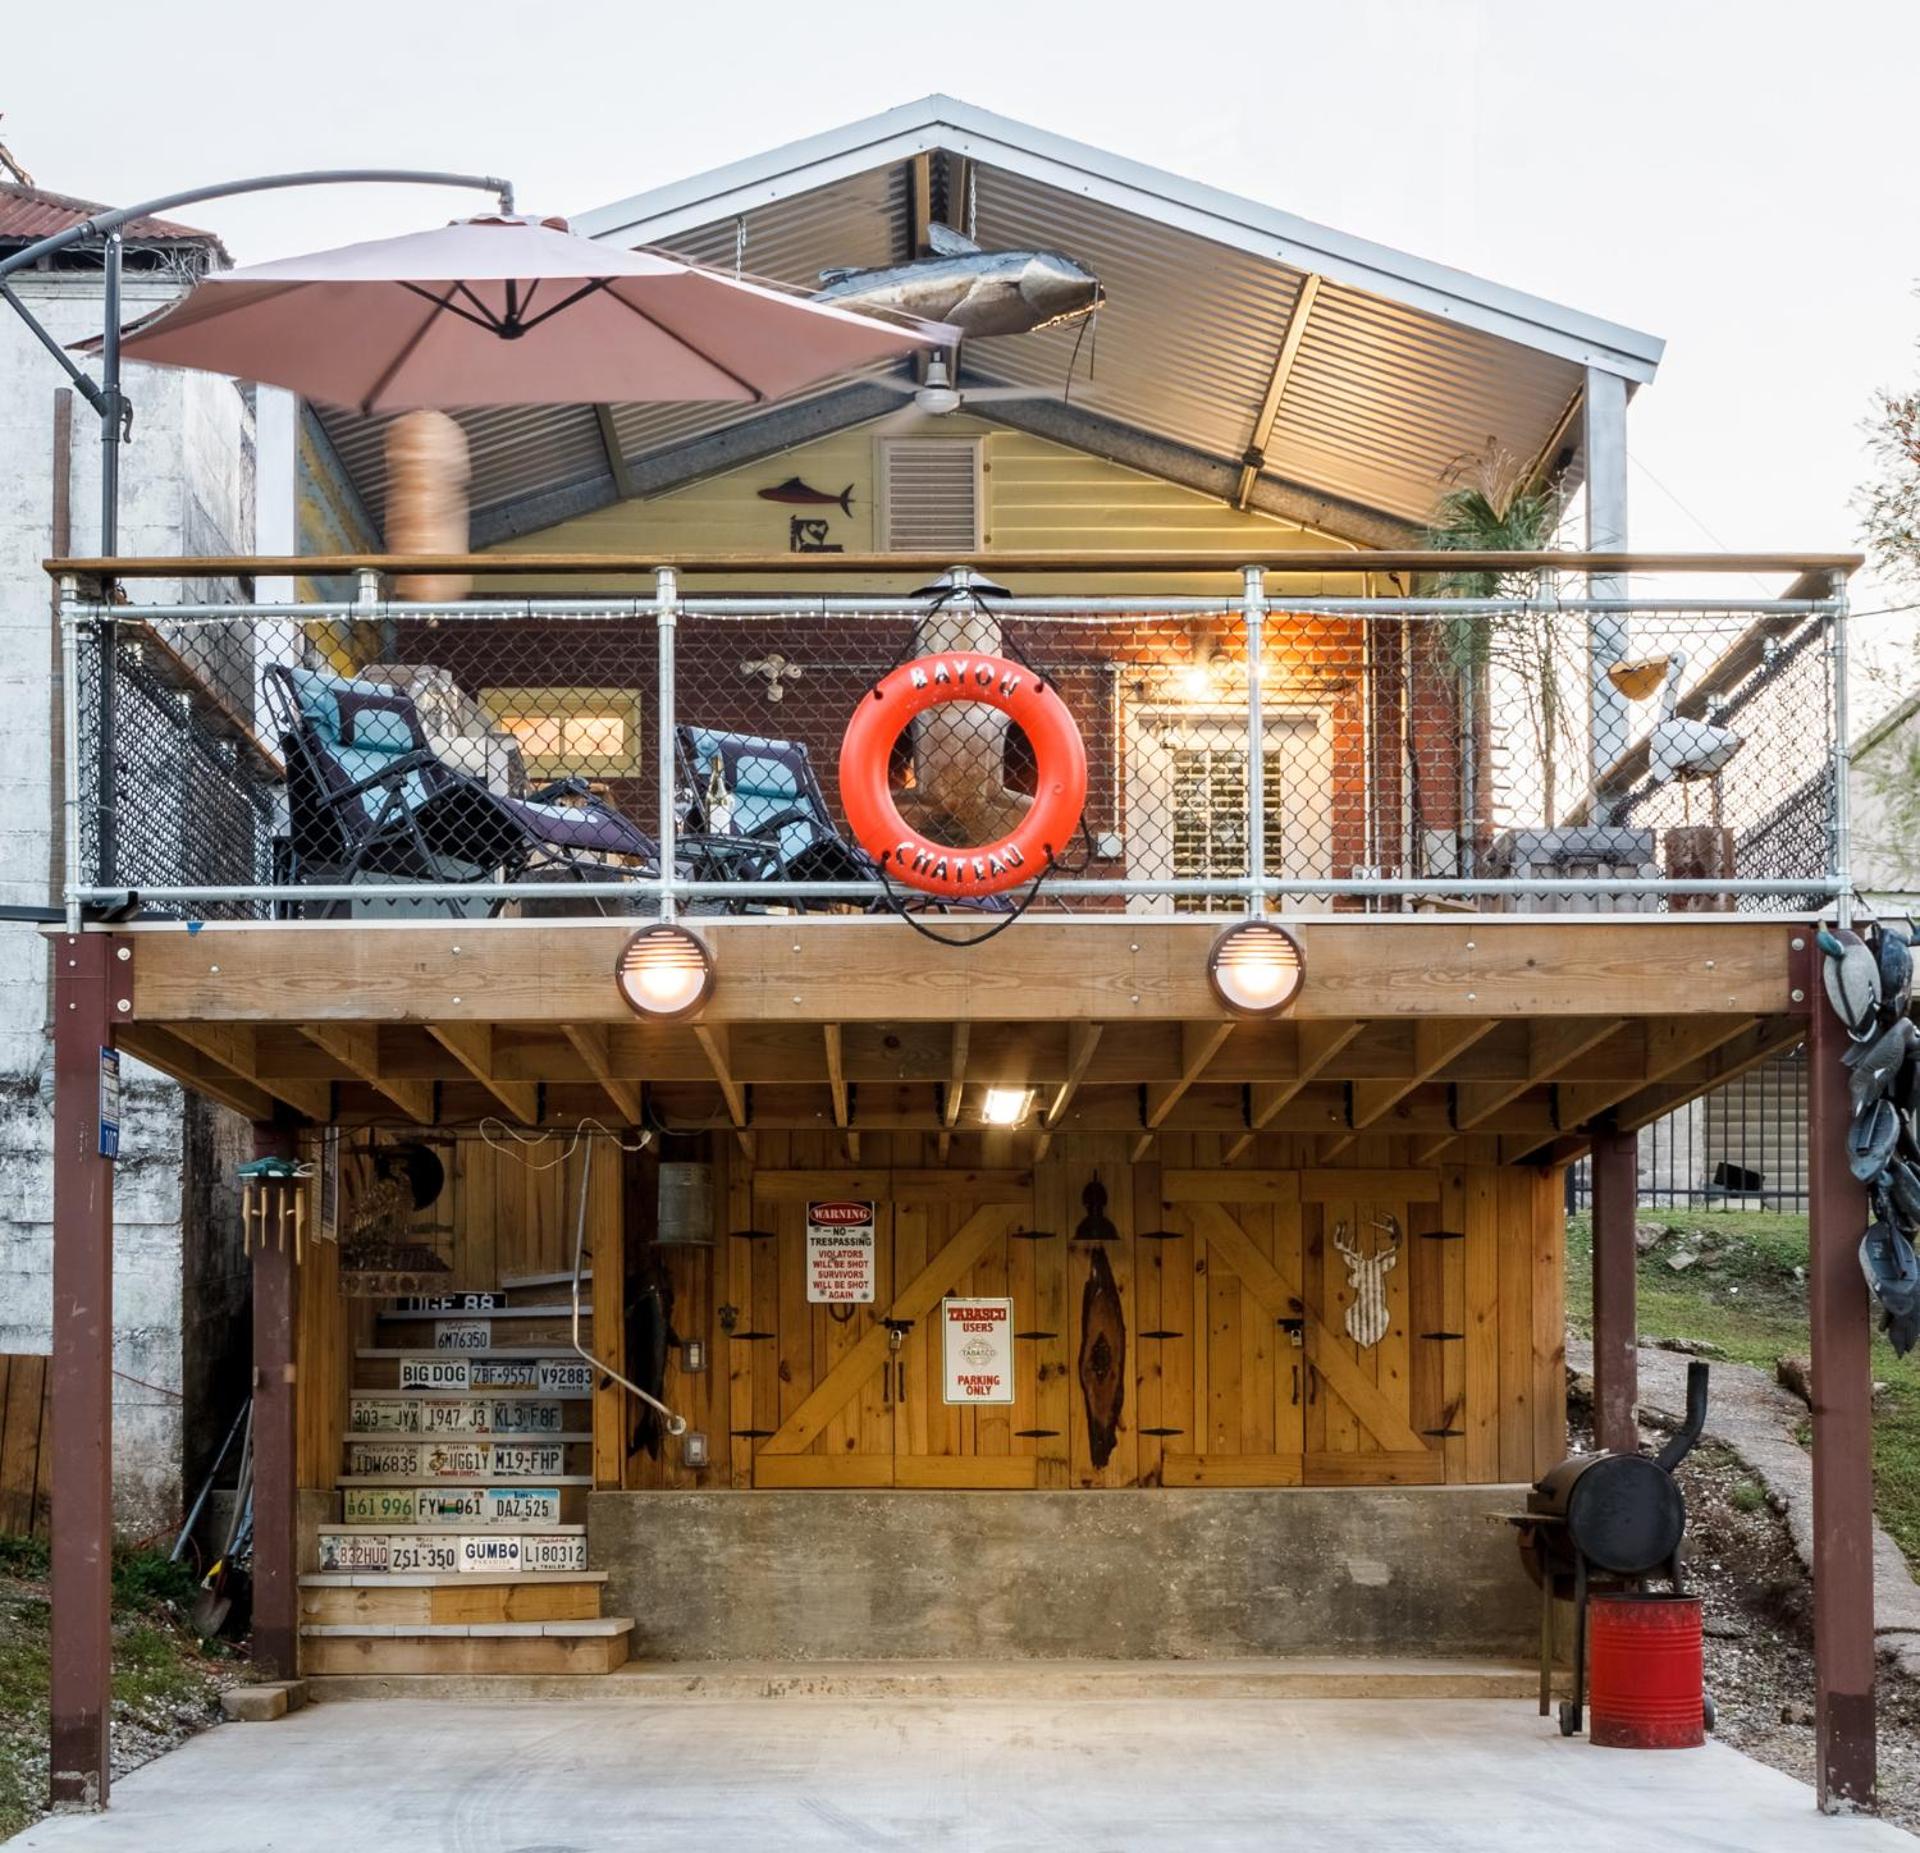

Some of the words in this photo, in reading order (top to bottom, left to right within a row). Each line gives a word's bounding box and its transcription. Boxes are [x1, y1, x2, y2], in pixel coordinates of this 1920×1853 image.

[909, 659, 1021, 697] BAYOU
[894, 841, 1025, 882] CHATEAU
[813, 1208, 868, 1219] WARNING
[833, 1227, 846, 1236] NO
[810, 1237, 872, 1246] TRESPASSING
[818, 1250, 864, 1258] VIOLATORS
[812, 1260, 832, 1268] WILL
[834, 1260, 845, 1268] BE
[847, 1260, 869, 1268] SHOT
[818, 1270, 864, 1279] SURVIVORS
[812, 1280, 832, 1289] WILL
[834, 1280, 845, 1289] BE
[847, 1280, 869, 1289] SHOT
[828, 1290, 854, 1299] AGAIN
[947, 1307, 1007, 1321] TABASCO
[963, 1322, 994, 1332] USERS
[403, 1366, 429, 1382] BIG
[433, 1366, 465, 1382] DOG
[957, 1374, 1000, 1386] PARKING
[966, 1385, 992, 1396] ONLY
[381, 1498, 412, 1516] 996
[525, 1499, 549, 1517] 525
[465, 1543, 519, 1559] GUMBO
